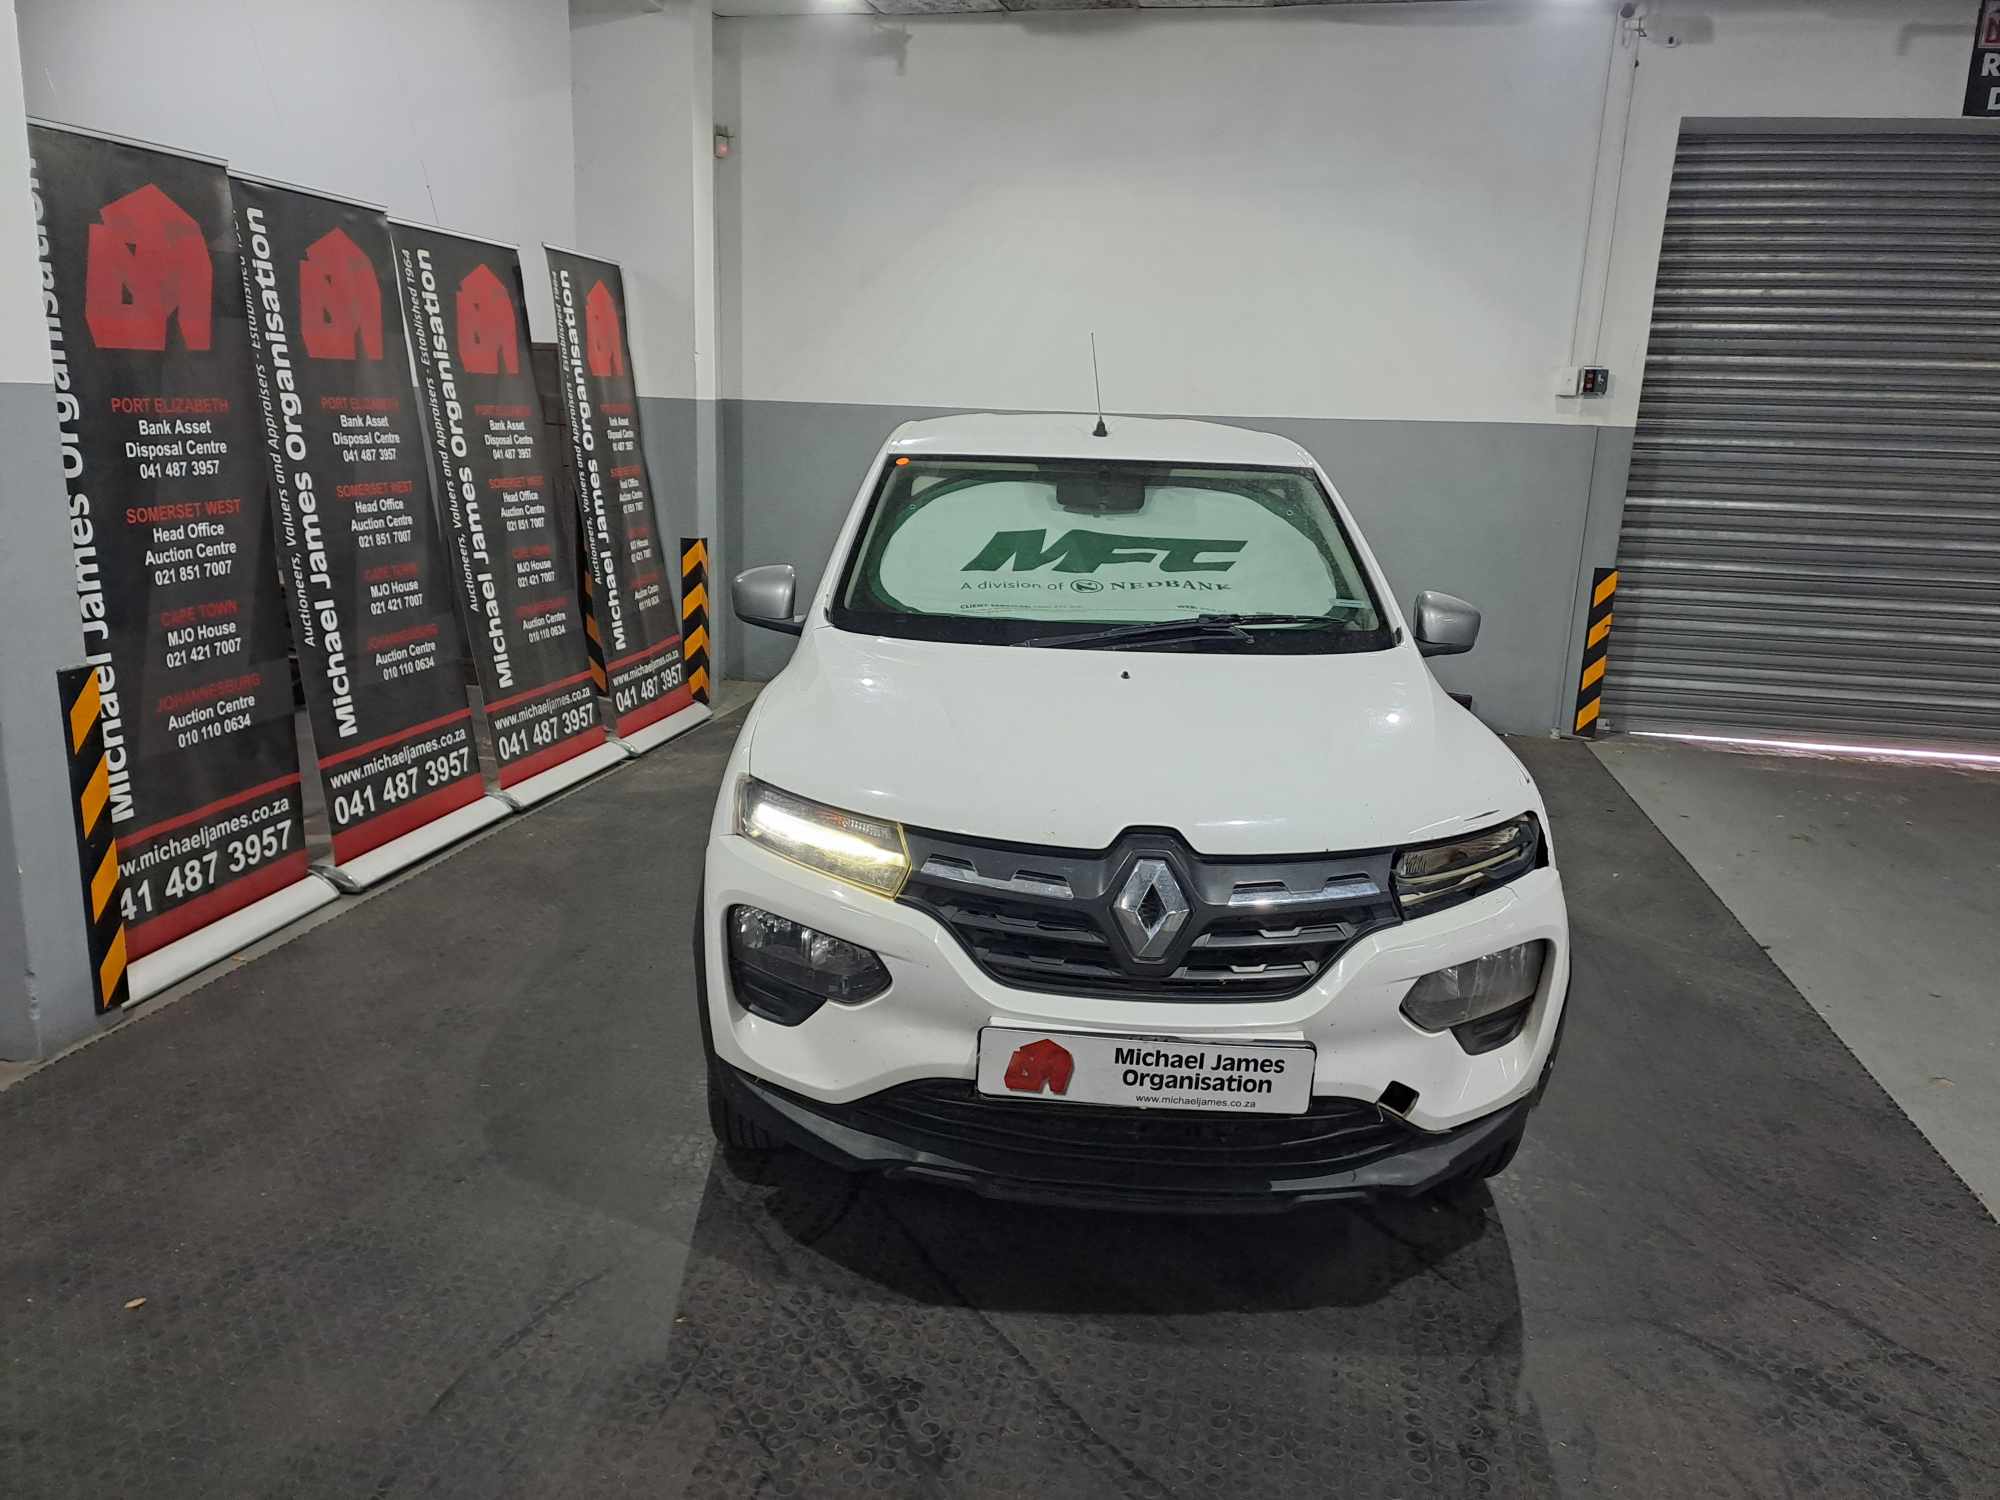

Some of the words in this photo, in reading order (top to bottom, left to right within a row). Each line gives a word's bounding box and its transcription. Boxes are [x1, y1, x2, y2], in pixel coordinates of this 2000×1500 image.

[402, 249, 415, 284] 1964
[246, 206, 307, 461] Organisation
[409, 287, 431, 366] Established
[417, 248, 467, 458] Organisation
[559, 269, 594, 452] Organisation
[111, 397, 150, 413] PORT
[255, 363, 280, 451] Appraisers
[340, 414, 364, 428] Bank
[365, 415, 389, 427] Asset
[426, 377, 447, 447] Appraisers
[138, 419, 172, 435] Bank
[175, 419, 212, 434] Asset
[332, 432, 372, 447] Disposal
[374, 432, 400, 443] Centre
[125, 441, 183, 460] Disposal
[186, 439, 227, 455] Centre
[343, 450, 359, 462] 041
[361, 449, 376, 461] 487
[379, 448, 396, 460] 3957
[438, 450, 452, 478] and
[574, 445, 584, 468] and
[139, 463, 162, 479] 041
[165, 461, 187, 477] 487
[191, 460, 220, 476] 3957
[270, 453, 286, 484] and
[355, 500, 378, 513] Head
[379, 498, 404, 510] Office
[446, 480, 463, 529] Valuers
[579, 471, 590, 513] Valuers
[588, 458, 609, 544] James
[126, 502, 201, 524] SOMERSET
[206, 498, 241, 515] WEST
[278, 488, 297, 548] Valuers
[351, 519, 385, 532] Auction
[386, 514, 413, 527] Centre
[458, 466, 490, 565] James
[152, 524, 185, 543] Head
[187, 522, 225, 539] Office
[294, 471, 331, 590] James
[358, 535, 374, 548] 021
[375, 533, 391, 546] 851
[393, 530, 412, 544] 7007
[69, 493, 109, 641] James
[144, 547, 194, 566] Auction
[196, 541, 237, 559] Centre
[960, 528, 1248, 573] MFC
[154, 568, 176, 586] 021
[179, 564, 200, 582] 851
[203, 559, 232, 578] 7007
[370, 584, 389, 598] MJO
[391, 580, 419, 594] House
[457, 533, 480, 613] Auctioneers,
[960, 581, 972, 590] A
[977, 580, 1041, 590] division
[1047, 582, 1064, 591] of
[1110, 579, 1232, 591] NEDBANK
[291, 551, 316, 648] Auctioneers,
[370, 602, 386, 616] 021
[388, 598, 402, 611] 421
[404, 593, 423, 608] 7007
[600, 550, 627, 651] Michael
[167, 627, 195, 647] MJO
[197, 621, 237, 639] House
[477, 572, 514, 689] Michael
[166, 651, 187, 668] 021
[190, 644, 211, 662] 421
[214, 637, 242, 656] 7007
[314, 598, 358, 738] Michael
[375, 648, 408, 666] Auction
[409, 641, 436, 657] Centre
[383, 667, 398, 680] 010
[399, 661, 414, 676] 110
[415, 656, 435, 672] 0634
[615, 685, 638, 713] 041
[640, 675, 658, 700] 487
[660, 662, 682, 690] 3957
[168, 707, 214, 731] Auction
[216, 695, 256, 714] Centre
[494, 686, 591, 730] www.michaeljames.co.za
[178, 730, 199, 748] 010
[202, 722, 221, 740] 110
[224, 713, 252, 734] 0634
[498, 728, 529, 761] 041
[533, 716, 558, 746] 487
[562, 702, 593, 734] 3957
[330, 728, 466, 789] www.michaeljames.co.za
[334, 784, 376, 825] 041
[383, 766, 418, 803] 487
[425, 746, 469, 787] 3957
[119, 797, 290, 877] w.michaeljames.co.za
[120, 879, 153, 921] 41
[165, 850, 218, 899] 487
[227, 819, 292, 873] 3957
[1114, 1047, 1204, 1070] Michael
[1210, 1054, 1286, 1073] James
[1122, 1068, 1273, 1094] Organisation
[1135, 1093, 1256, 1109] www.michaeljames.co.za
